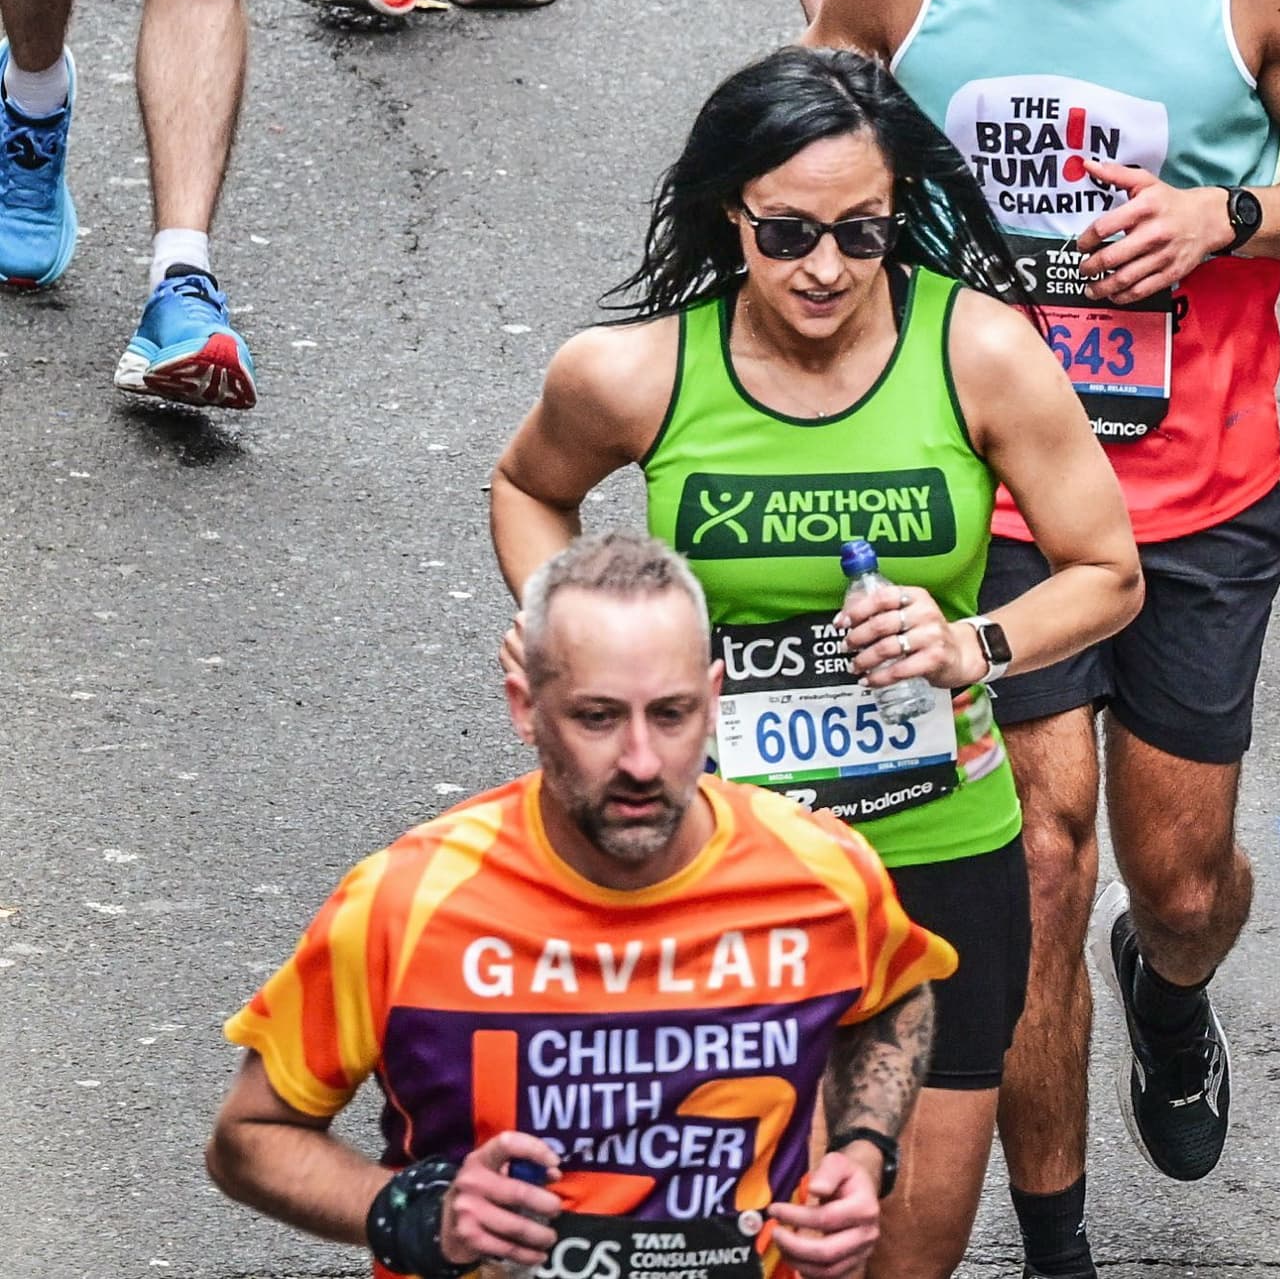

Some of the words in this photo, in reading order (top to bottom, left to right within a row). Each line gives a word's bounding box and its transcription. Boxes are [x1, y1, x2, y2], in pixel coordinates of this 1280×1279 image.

[1010, 96, 1061, 120] THE
[999, 188, 1114, 215] CHARITY
[1050, 324, 1135, 377] 643
[764, 485, 931, 513] ANTHONY
[761, 511, 933, 543] NOLAN
[722, 634, 806, 681] tcs
[860, 779, 934, 815] balance
[461, 927, 810, 998] GAVLAR
[528, 1018, 798, 1078] CHILDREN
[528, 1080, 663, 1130] WITH
[665, 1174, 738, 1219] UK
[537, 1237, 622, 1279] cs
[630, 1246, 751, 1269] CONSULTANCY
[631, 1232, 686, 1250] TATA
